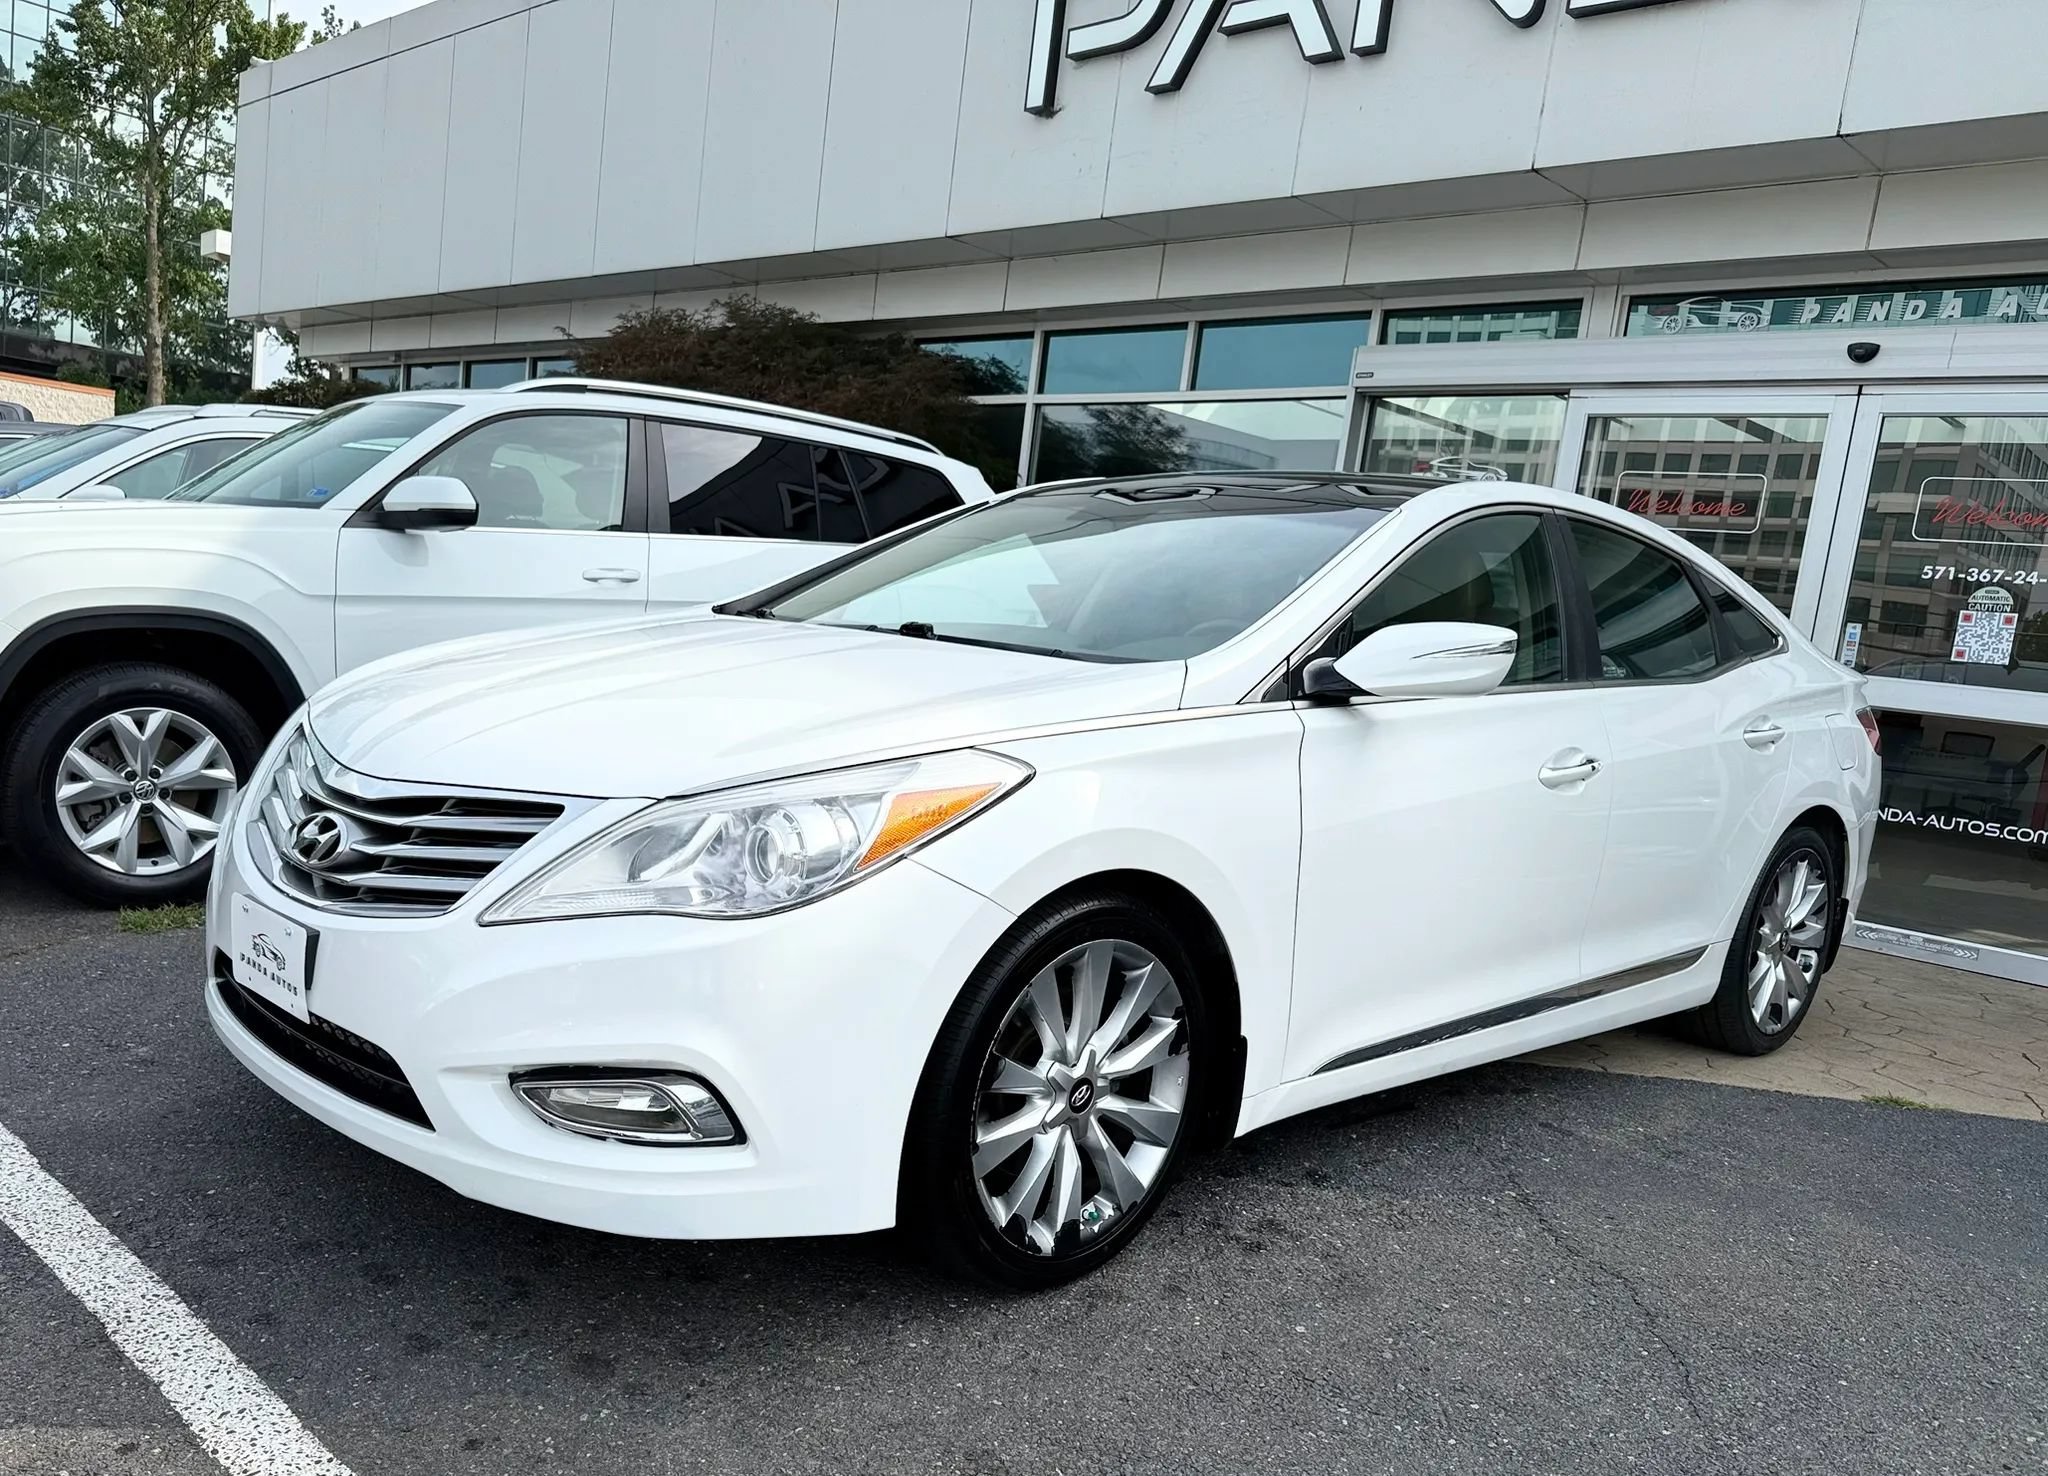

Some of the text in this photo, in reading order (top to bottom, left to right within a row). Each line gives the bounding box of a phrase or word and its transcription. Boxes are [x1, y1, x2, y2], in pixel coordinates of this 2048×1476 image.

[1799, 297, 1963, 324] PANDA
[1626, 488, 1747, 517] Welcome
[1968, 603, 2012, 612] CAUTION
[1971, 594, 2010, 603] AUTOMATIC
[240, 952, 298, 996] PANDA AUTOS
